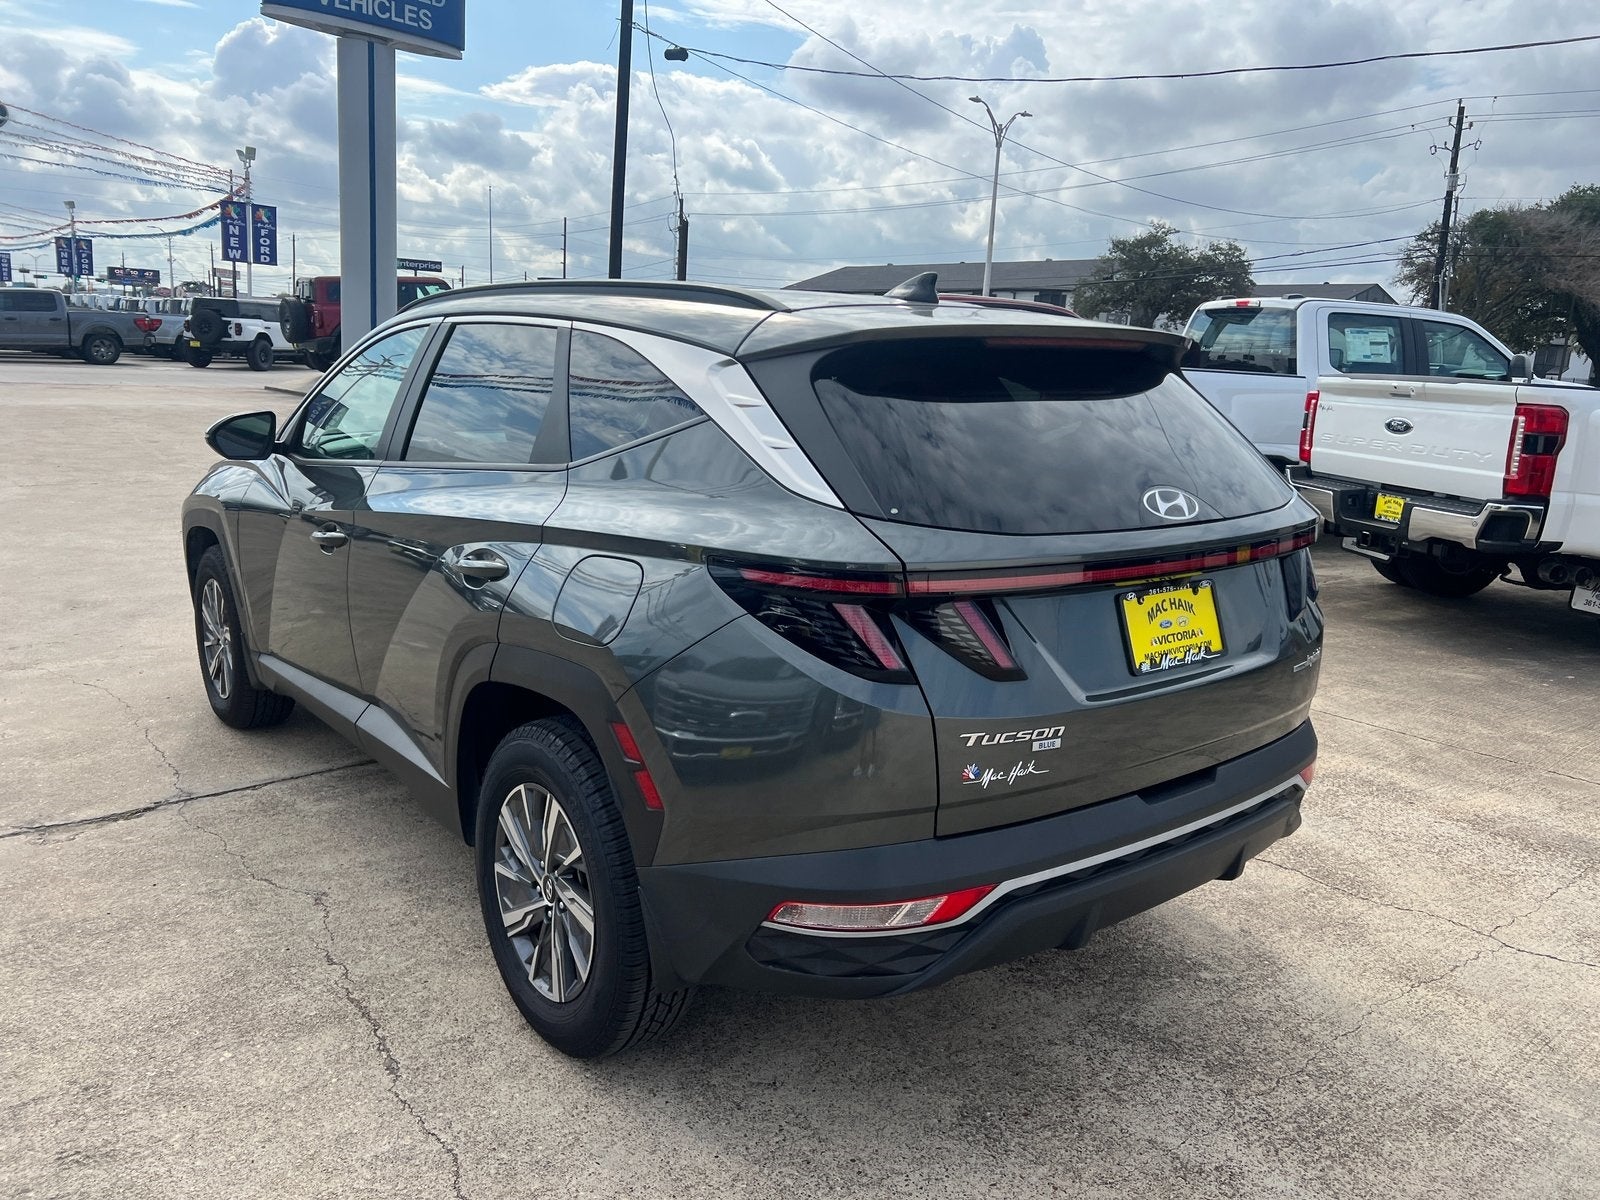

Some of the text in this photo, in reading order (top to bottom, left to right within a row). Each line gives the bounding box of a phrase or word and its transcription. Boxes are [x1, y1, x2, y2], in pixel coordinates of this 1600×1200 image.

[227, 225, 242, 259] NEW
[259, 229, 271, 262] FORD
[399, 260, 441, 270] nterprise
[1321, 433, 1493, 463] SUPER DUTY
[1147, 597, 1196, 625] MAC HAIK
[1157, 629, 1197, 645] VICTORIA
[1153, 654, 1184, 670] Mac
[1038, 740, 1057, 750] BLUE
[968, 760, 1047, 789] Mac Haik
